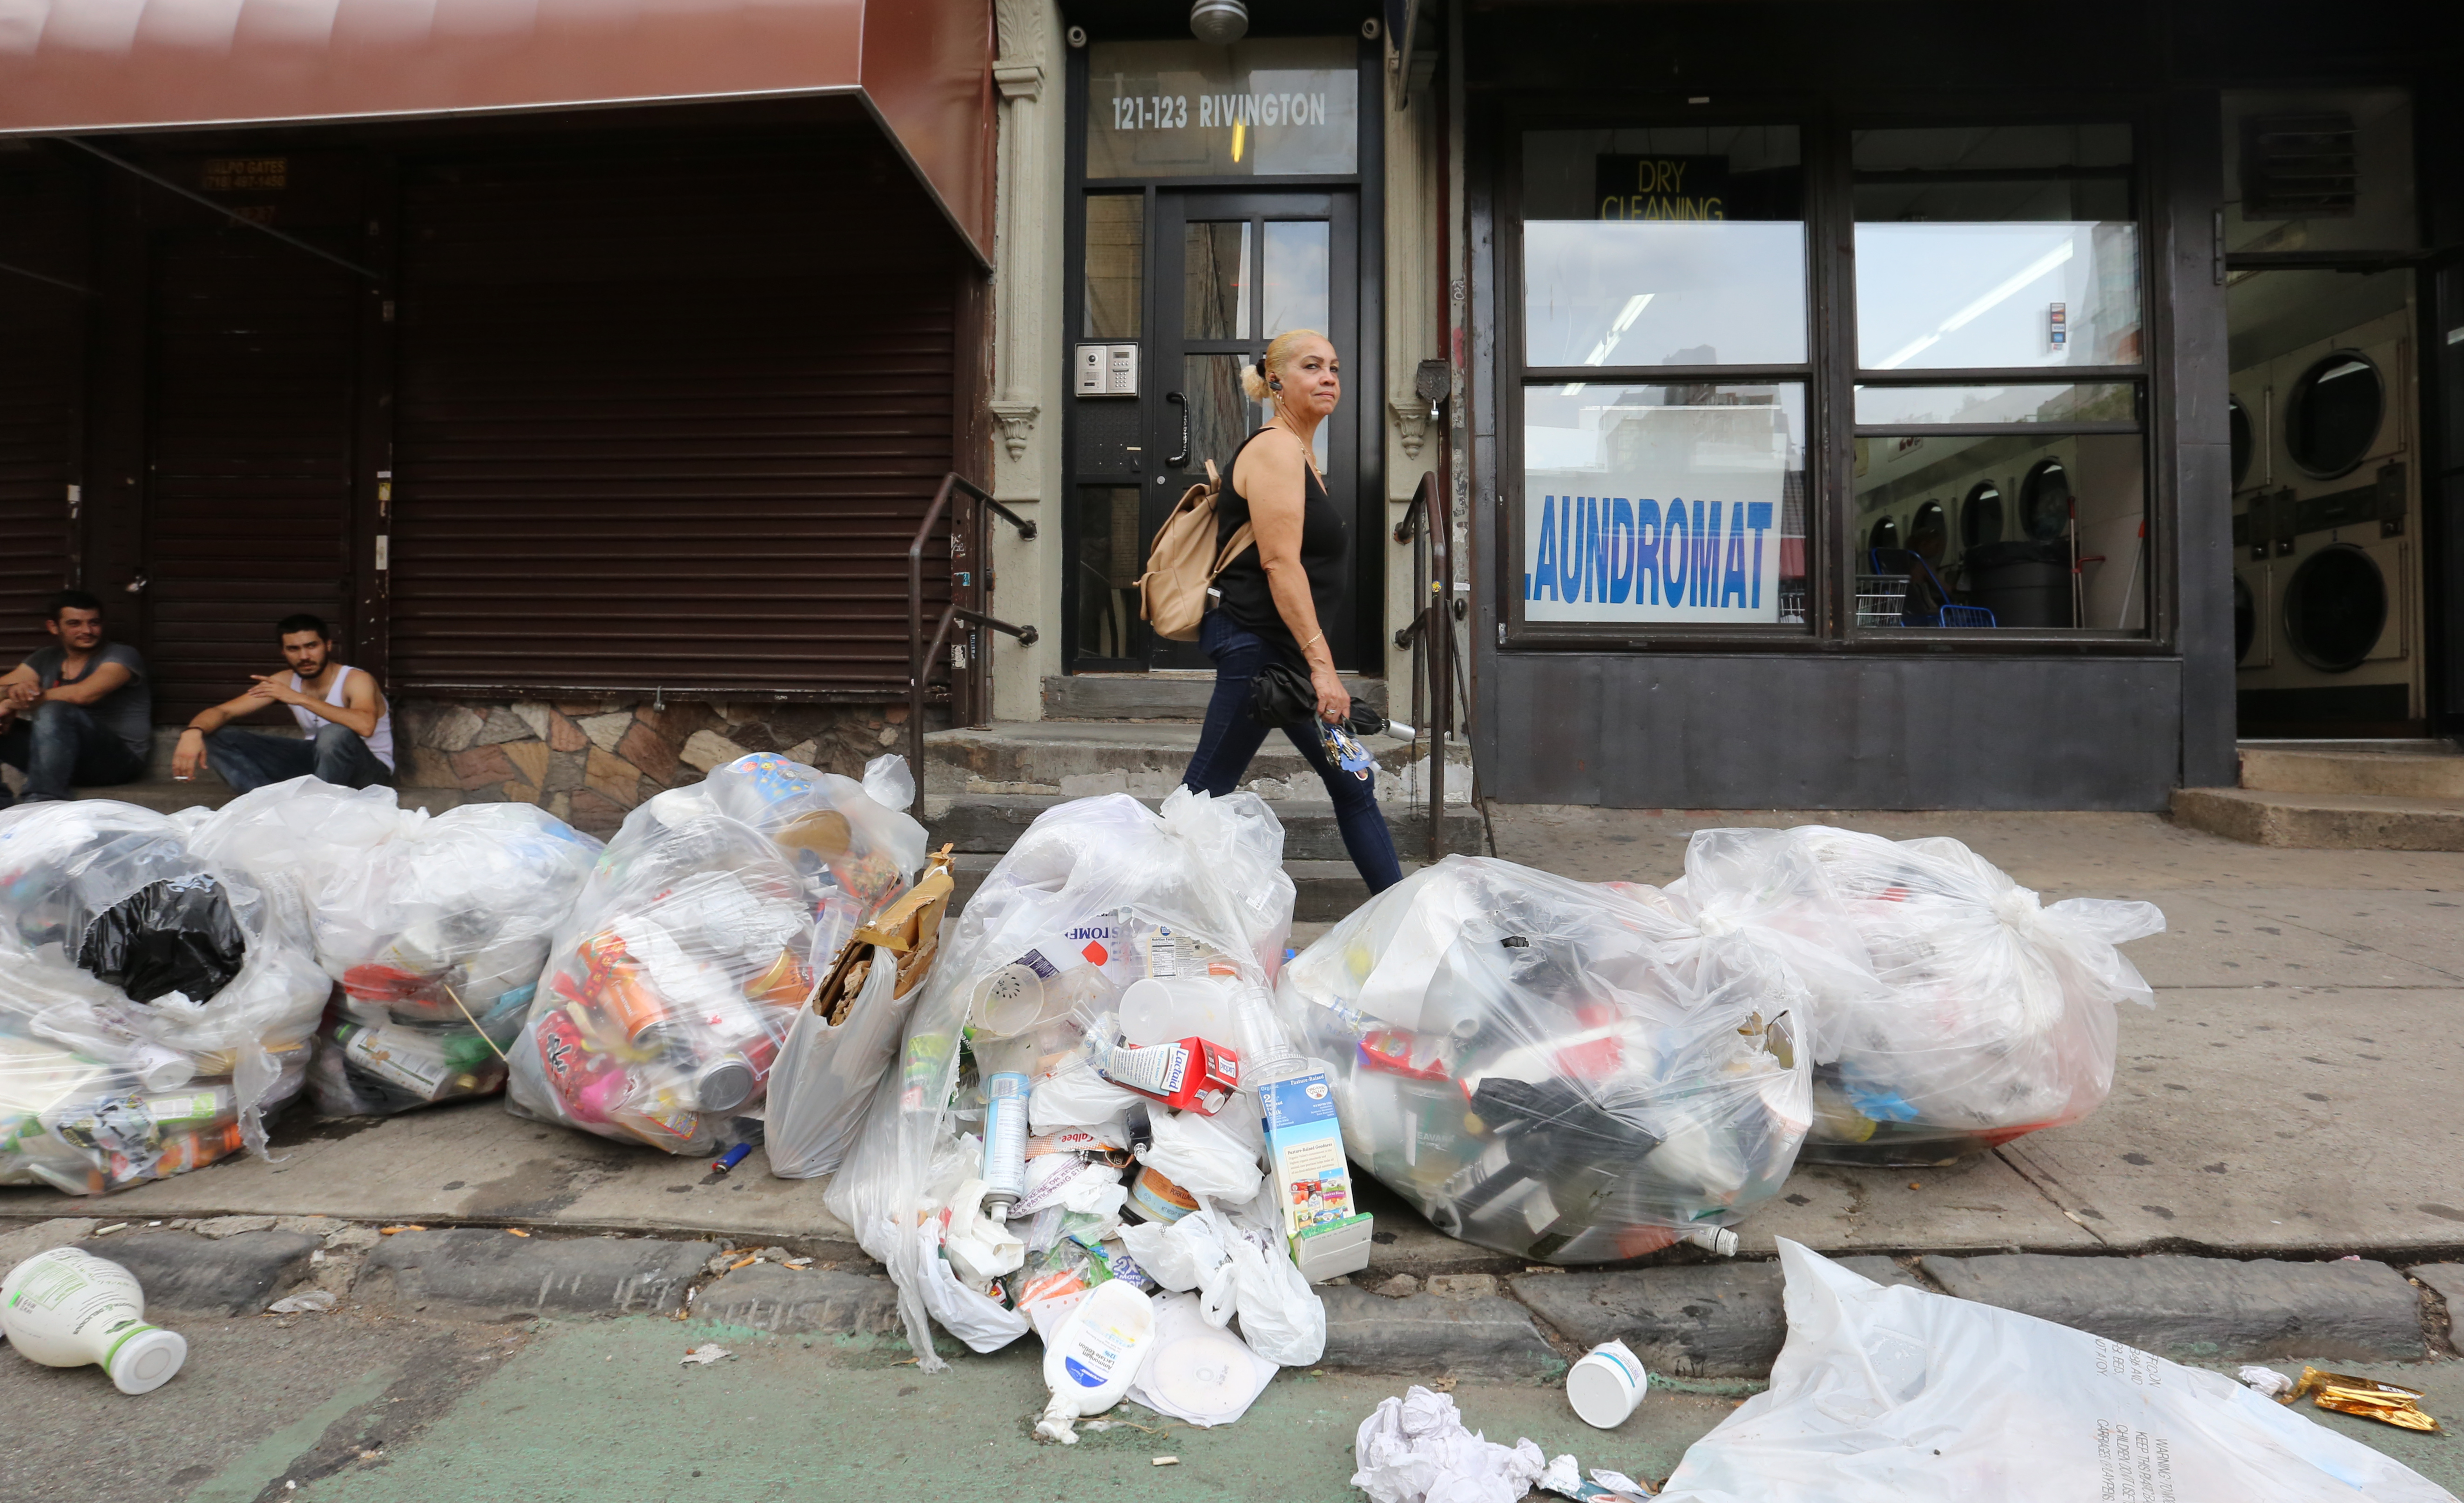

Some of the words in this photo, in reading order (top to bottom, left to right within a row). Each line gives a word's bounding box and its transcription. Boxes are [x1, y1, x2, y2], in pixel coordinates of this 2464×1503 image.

[1113, 95, 1187, 129] 121-123
[1200, 92, 1325, 128] RIVINGTON
[1639, 160, 1686, 193] DRY
[1601, 195, 1723, 222] CLEANING
[1525, 495, 1773, 609] AUNDROMAT
[620, 994, 634, 1016] NATURAL
[1169, 1050, 1186, 1090] Lactaid
[1290, 1074, 1324, 1085] Pasture-Raised
[1287, 1146, 1315, 1155] Pasture-Raised
[1169, 1188, 1182, 1198] PORK
[1114, 1257, 1139, 1275] 2X
[73, 1307, 105, 1335] DELICIOUS
[1078, 1341, 1095, 1355] Lotion
[1105, 1350, 1116, 1359] 12%
[1082, 1351, 1113, 1370] Ammonium
[1095, 1353, 1115, 1366] Lactate
[2131, 1367, 2143, 1385] AND
[2097, 1419, 2111, 1460] CARRIAGES
[2135, 1431, 2149, 1454] KEEP
[2137, 1455, 2151, 1472] THIS
[2155, 1439, 2171, 1481] WARNING:
